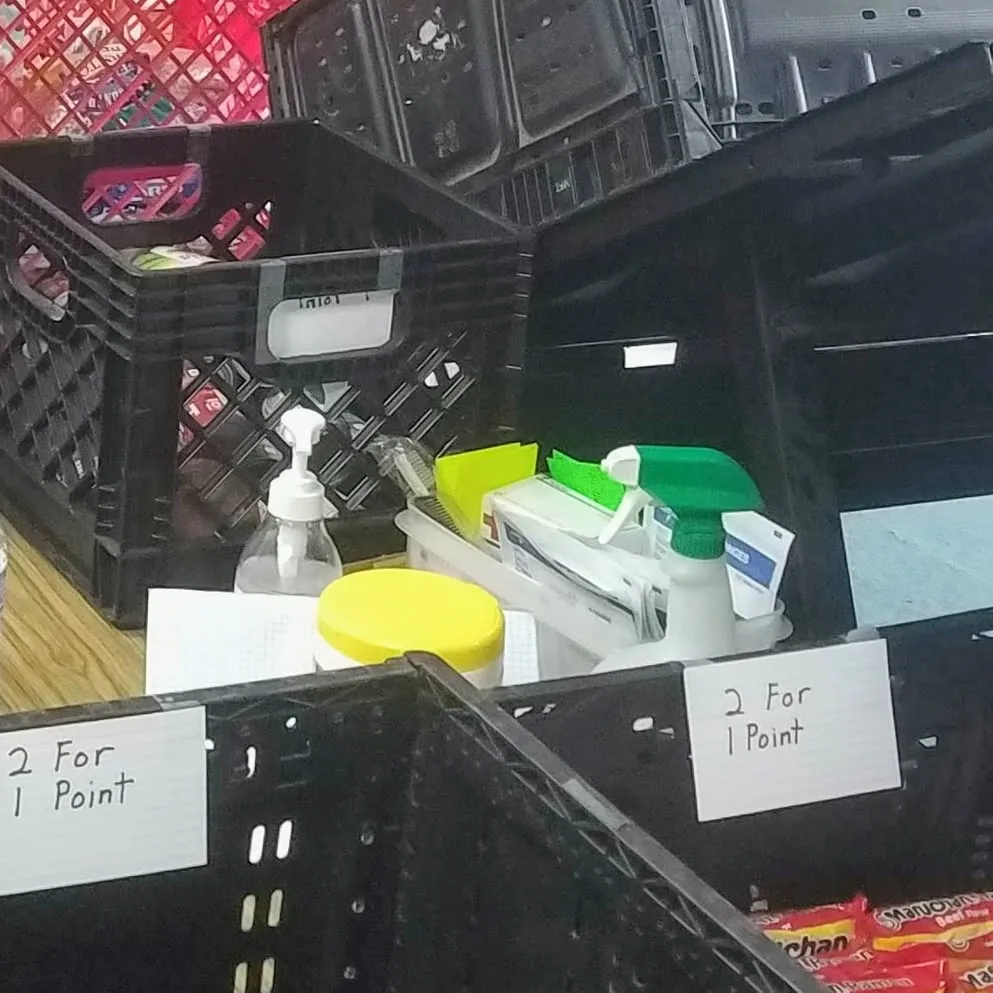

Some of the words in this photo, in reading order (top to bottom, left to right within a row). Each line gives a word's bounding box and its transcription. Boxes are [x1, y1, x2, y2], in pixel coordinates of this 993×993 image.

[724, 688, 745, 717] 2
[766, 682, 812, 711] For
[727, 726, 734, 756] 1
[746, 717, 805, 752] Point
[7, 746, 33, 777] 2
[54, 739, 116, 772] For
[13, 786, 22, 818] 1
[54, 771, 136, 811] Point
[935, 911, 965, 928] Beef
